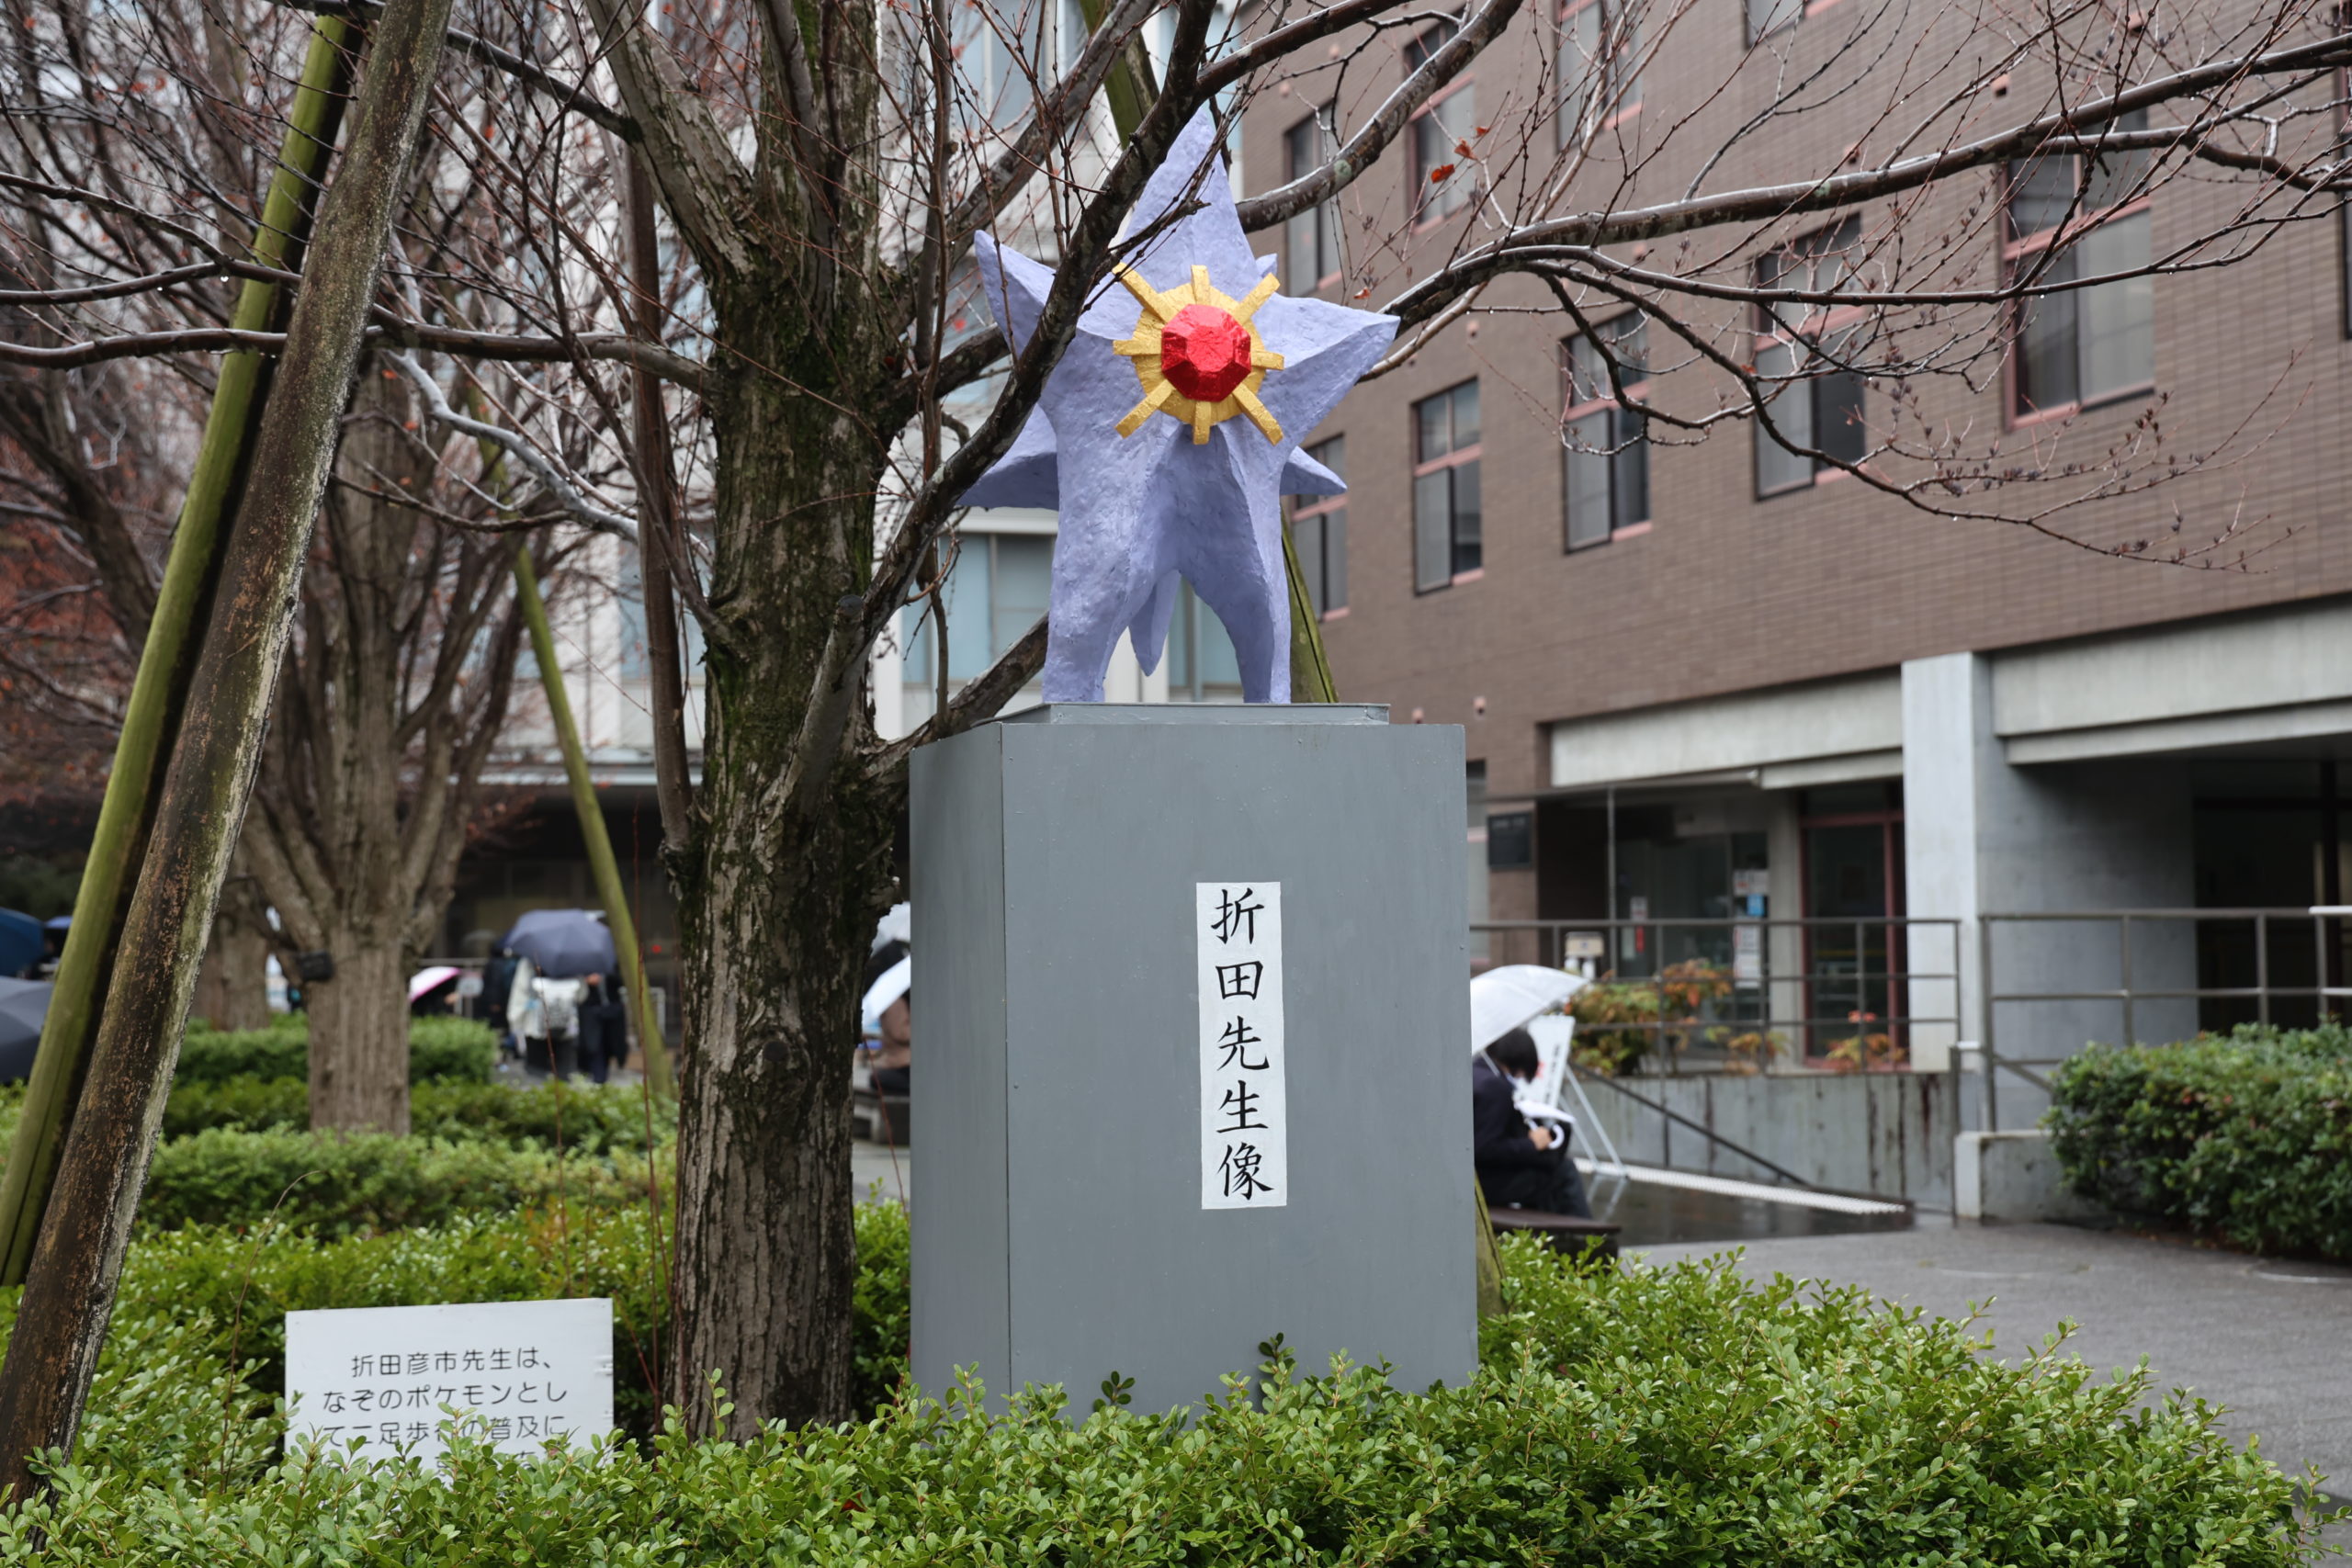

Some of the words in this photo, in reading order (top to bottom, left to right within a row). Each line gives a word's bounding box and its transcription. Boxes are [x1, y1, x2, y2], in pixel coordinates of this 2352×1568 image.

[1211, 887, 1274, 1201] 折田先生像
[351, 1347, 551, 1378] 折田彦市先生は、
[323, 1382, 567, 1413] なぞのポケモンとし
